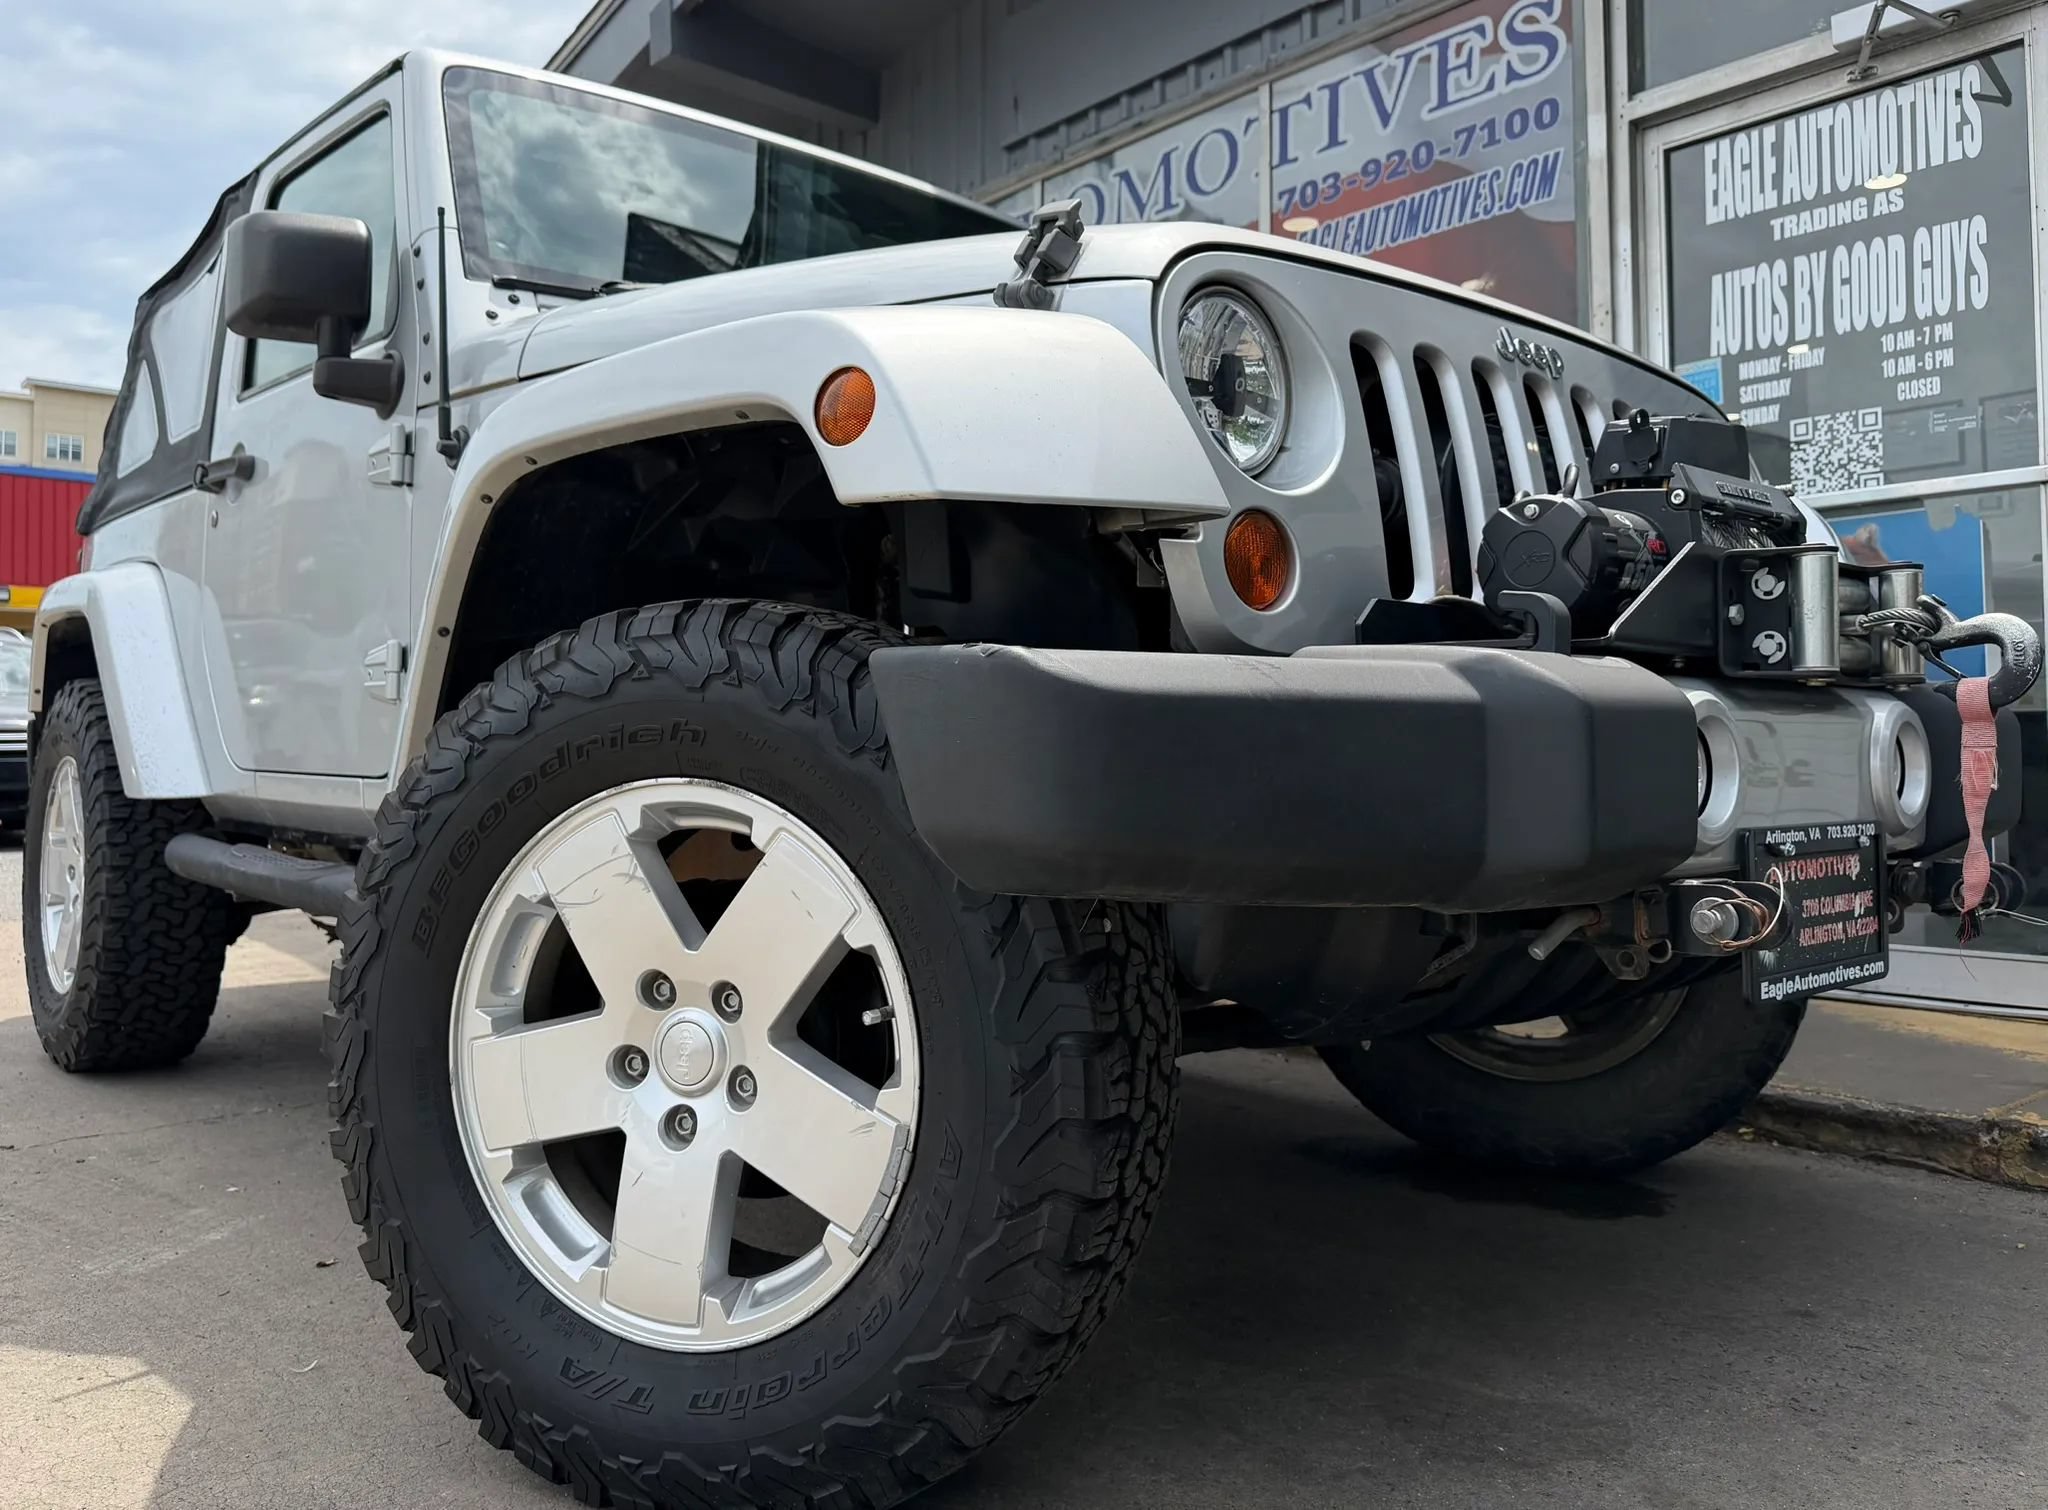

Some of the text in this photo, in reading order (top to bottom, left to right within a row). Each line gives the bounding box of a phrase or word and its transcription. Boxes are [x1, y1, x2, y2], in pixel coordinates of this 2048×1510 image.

[1014, 0, 1562, 227] OMOTIVES
[1278, 97, 1561, 217] 703-920-7100
[1704, 64, 1983, 226] EAGLE AUTOMOTIVES
[1770, 188, 1905, 242] TRADING AS
[1709, 214, 1989, 358] AUTOS BY GOOD GUYS
[1494, 326, 1564, 380] Jeep
[1880, 333, 1895, 353] 10
[1896, 328, 1915, 351] AM
[1923, 325, 1930, 345] 7
[1934, 321, 1954, 343] PM
[1739, 355, 1781, 381] MONDAY
[1788, 346, 1825, 372] FRIDAY
[1881, 358, 1896, 379] 10
[1897, 354, 1916, 376] AM
[1924, 351, 1933, 371] 6
[1935, 347, 1954, 369] PM
[1739, 377, 1791, 404] SATURDAY
[1897, 375, 1941, 401] CLOSED
[1740, 403, 1780, 427] SUNDAY
[411, 717, 706, 958] BFGoodrich
[1765, 823, 1876, 844] Arlington, VA 703.920.7100
[1760, 960, 1884, 1000] EagleAutomotives.com
[676, 1026, 694, 1080] Jeep
